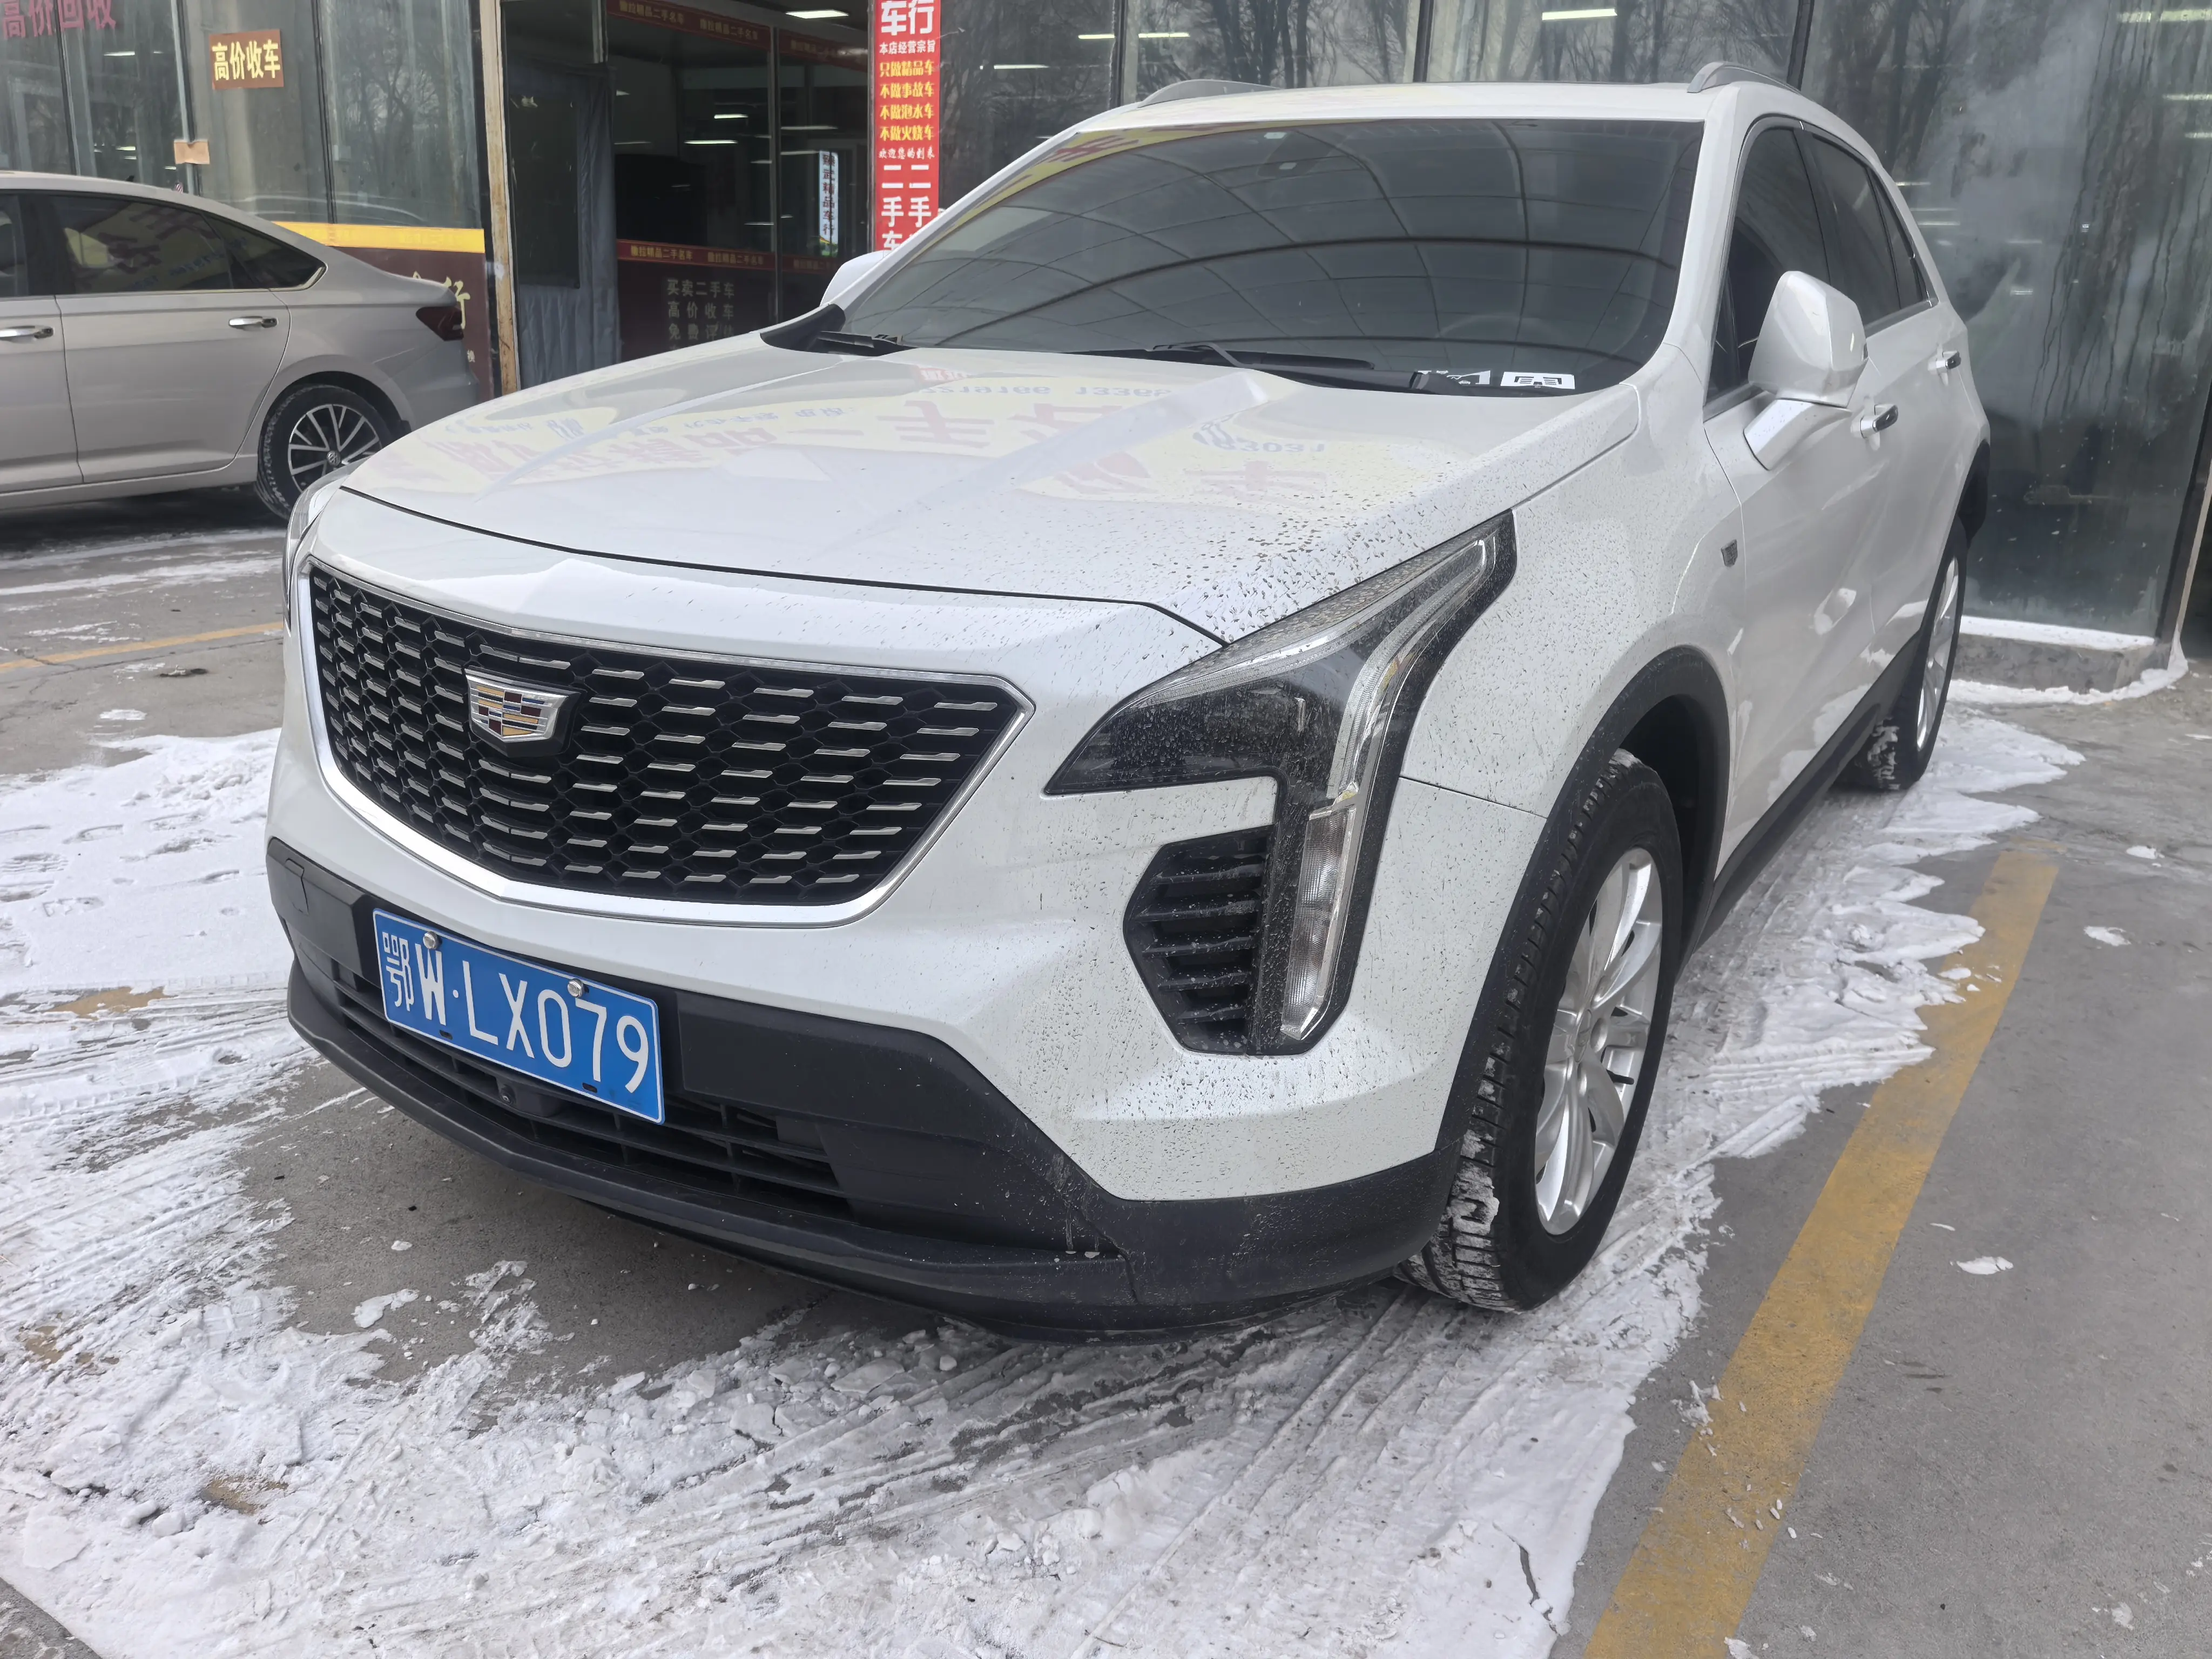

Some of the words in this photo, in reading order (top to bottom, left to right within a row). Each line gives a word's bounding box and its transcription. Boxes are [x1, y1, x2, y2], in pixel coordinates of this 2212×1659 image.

[0, 0, 116, 39] 高价回收
[881, 0, 934, 36] 车行
[879, 39, 935, 55] 本店经营宗旨
[212, 39, 281, 80] 高价收车
[879, 59, 934, 77] 只做精品车
[880, 81, 934, 99] 不做事故车
[880, 103, 934, 120] 不做泡水车
[880, 125, 934, 141] 不做火烧车
[879, 145, 935, 160] 欢迎您的到来
[667, 279, 734, 299] 买卖二手车
[667, 301, 734, 321] 高价收车
